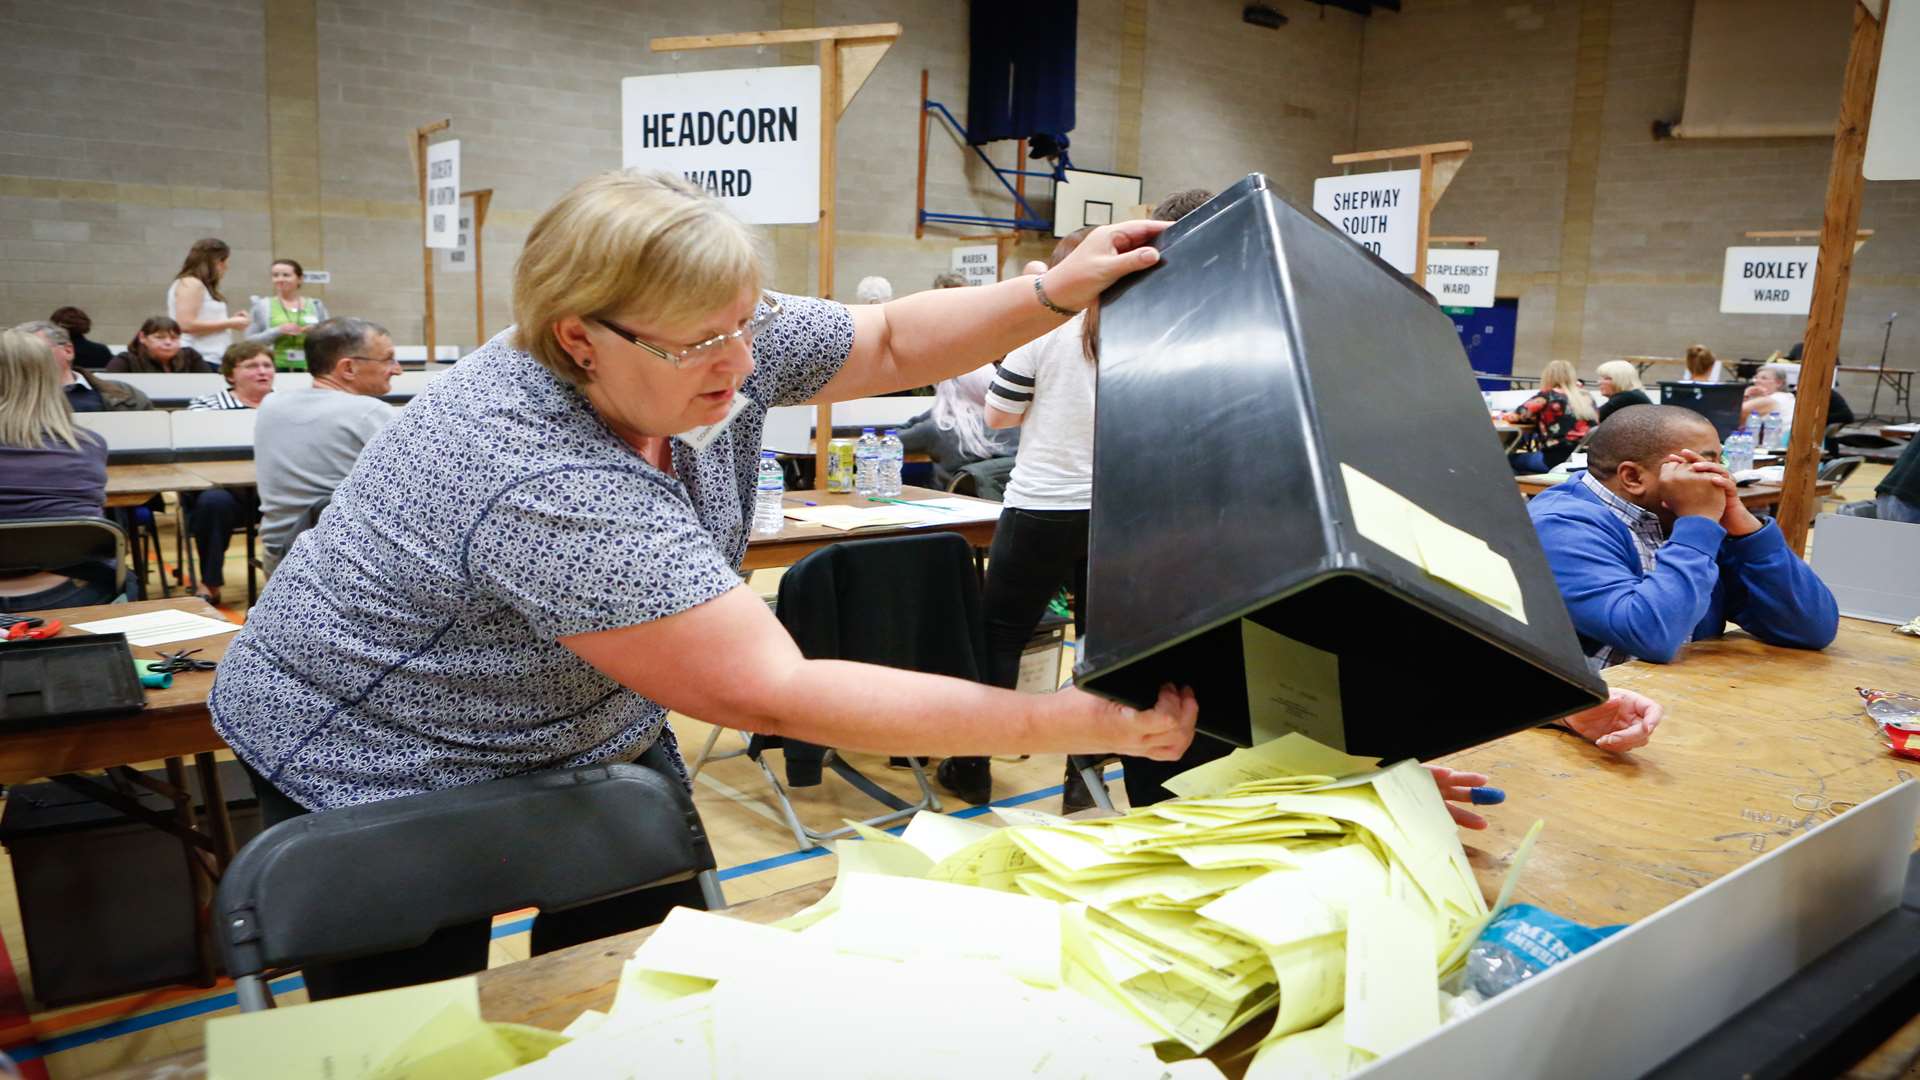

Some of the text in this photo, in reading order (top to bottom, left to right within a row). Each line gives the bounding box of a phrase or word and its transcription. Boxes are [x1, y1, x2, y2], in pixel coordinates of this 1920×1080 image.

[643, 106, 797, 148] HEADCORN
[1333, 188, 1400, 211] SHEPWAY
[1343, 215, 1387, 235] SOUTH
[1427, 264, 1489, 276] STAPLEHURST
[1743, 262, 1808, 279] BOXLEY
[1443, 283, 1471, 294] WARD
[1754, 289, 1790, 301] WARD
